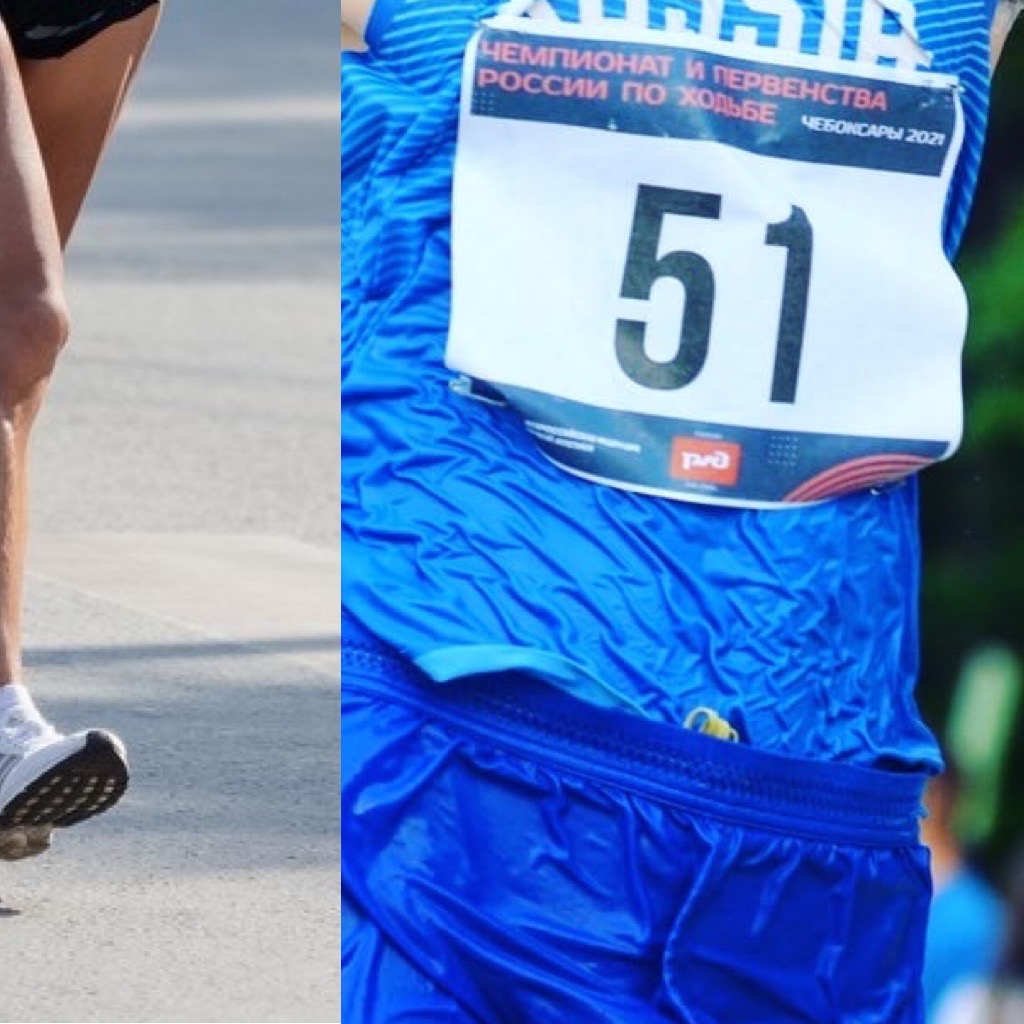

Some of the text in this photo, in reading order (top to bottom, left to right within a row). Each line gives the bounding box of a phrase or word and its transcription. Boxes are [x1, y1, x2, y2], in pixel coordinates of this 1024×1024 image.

[477, 68, 778, 125] РОССИИ ПО ХОДЬБЕ
[480, 39, 888, 112] ЧЕМПИОНАТ И ПЕРВЕНСТВА
[801, 114, 946, 147] ЧЕБОКСАРЫ 2021
[613, 182, 814, 405] 51
